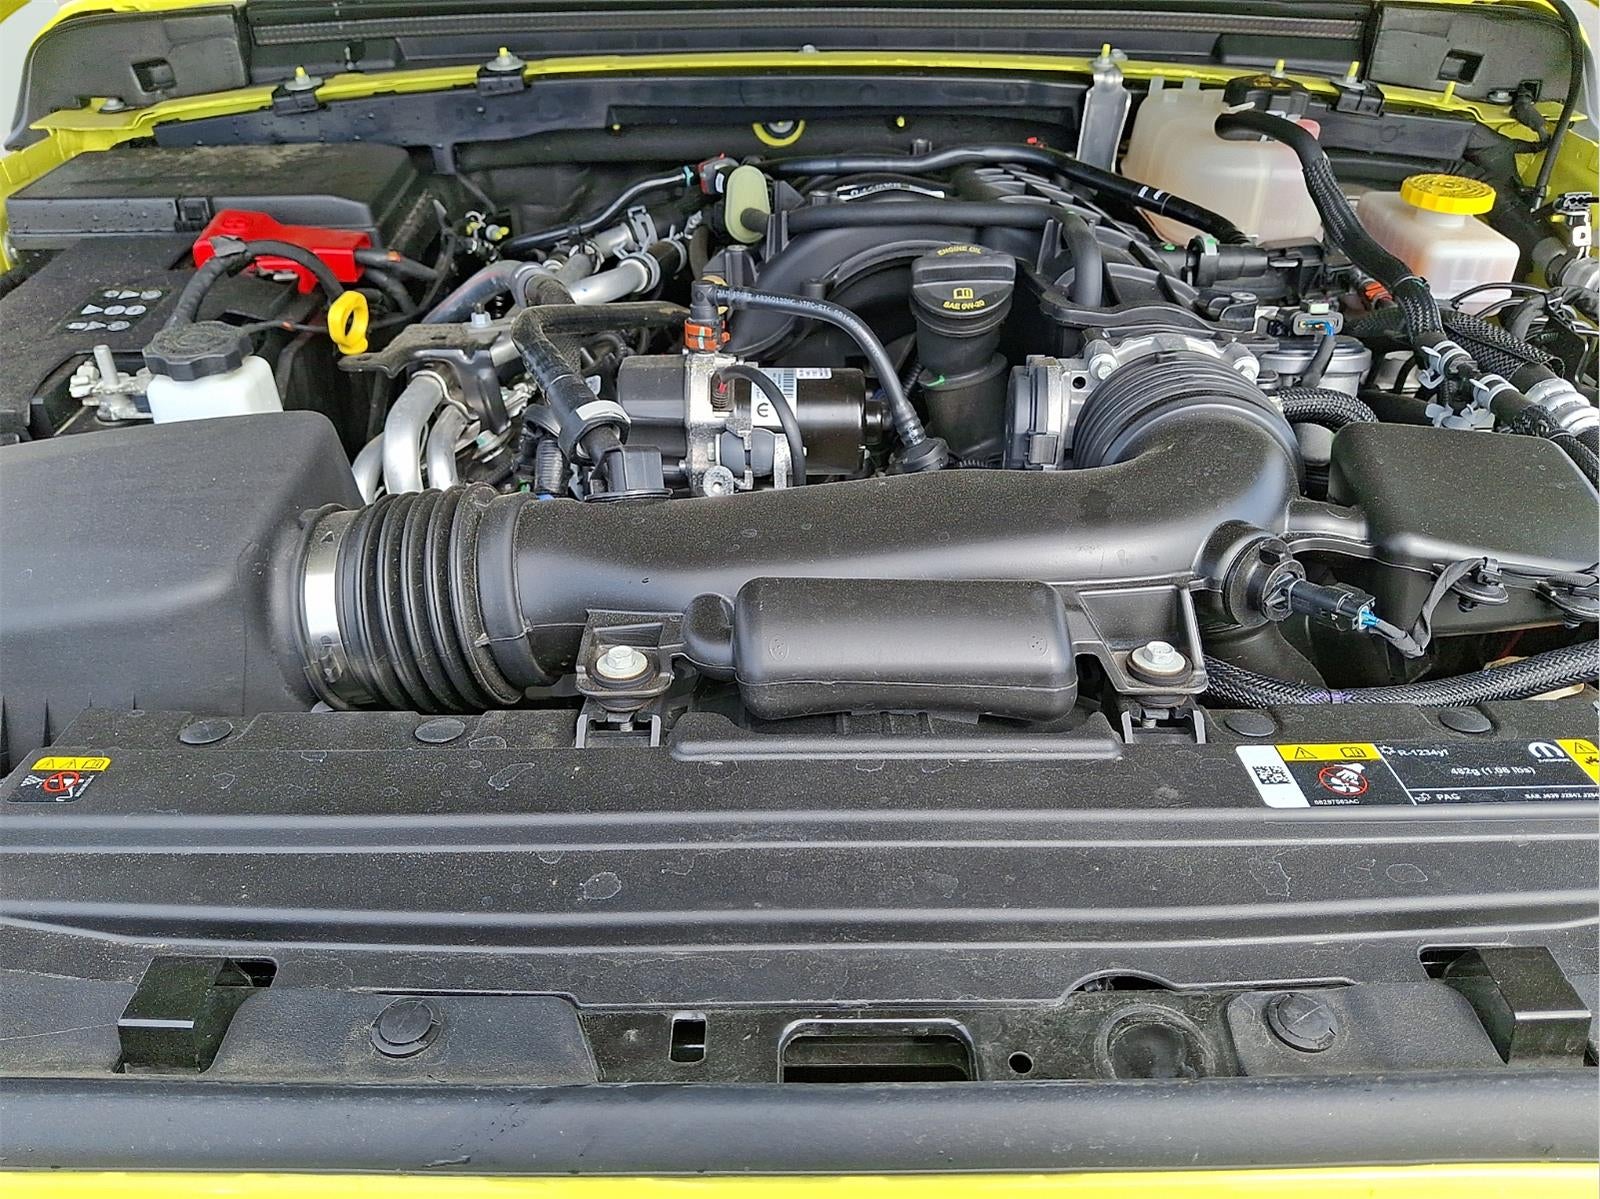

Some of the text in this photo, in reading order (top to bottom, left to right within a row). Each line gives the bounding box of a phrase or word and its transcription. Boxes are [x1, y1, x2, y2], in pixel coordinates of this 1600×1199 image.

[937, 245, 982, 256] ENGINE OIL
[943, 301, 961, 310] SAE
[1397, 748, 1449, 758] R-1234yf
[1436, 793, 1461, 801] PAG
